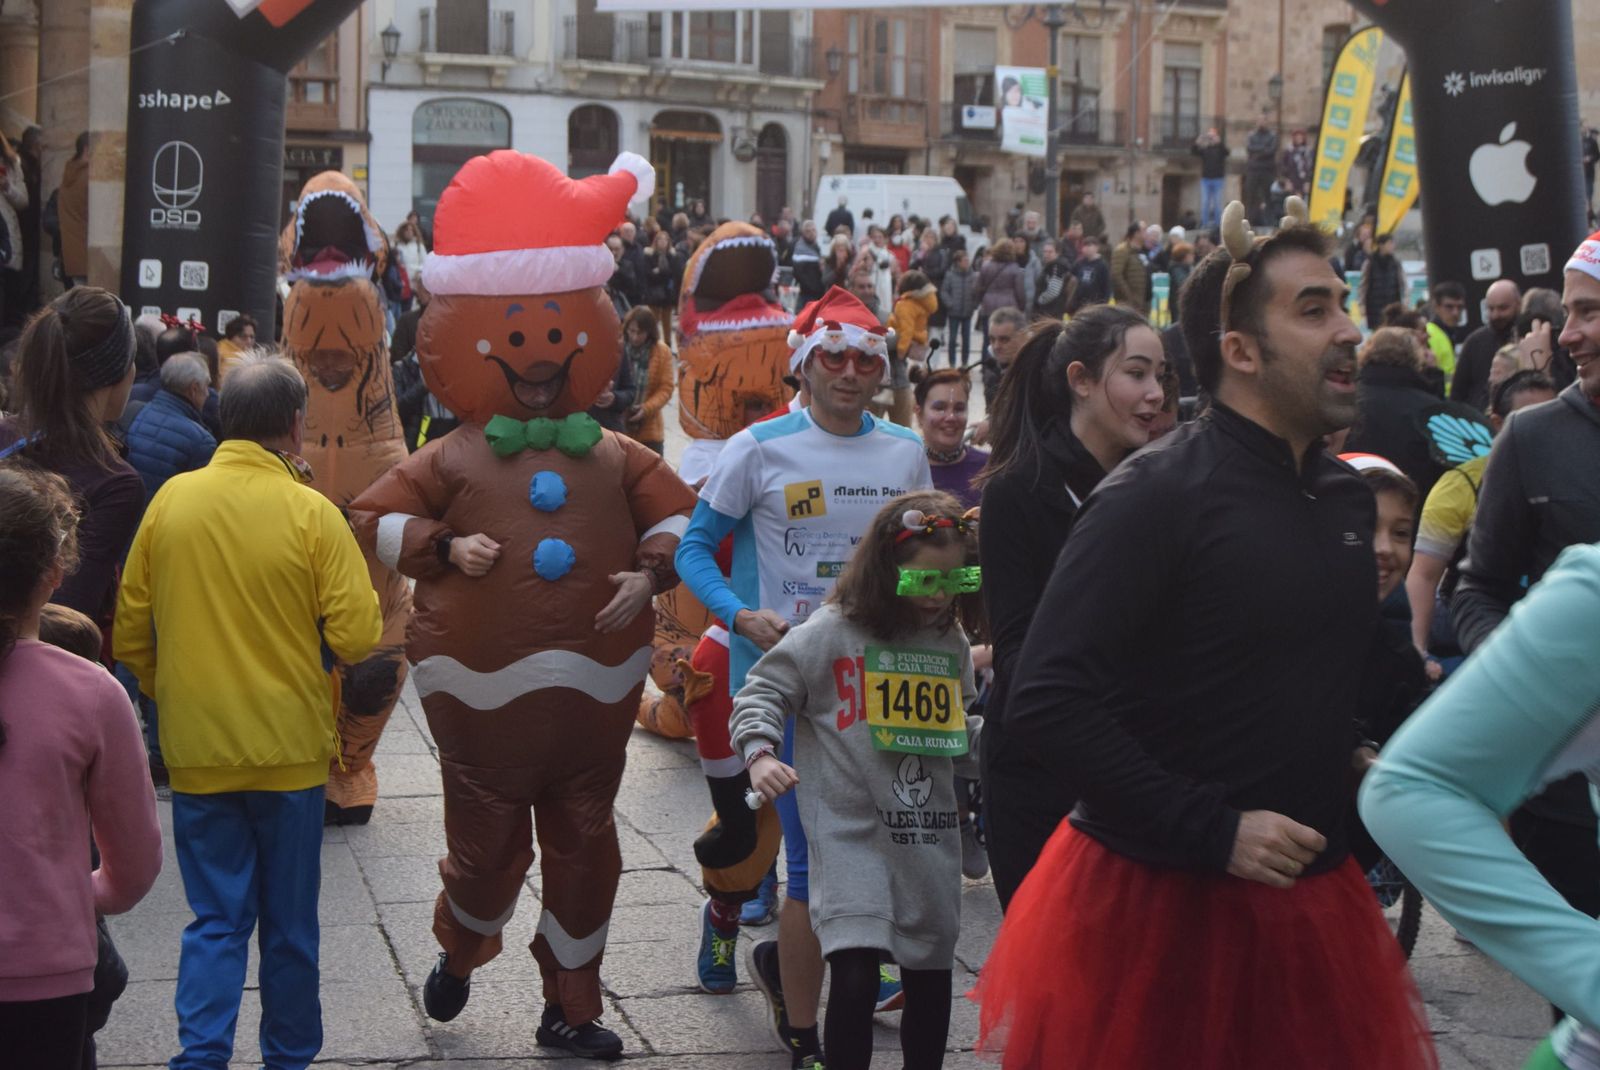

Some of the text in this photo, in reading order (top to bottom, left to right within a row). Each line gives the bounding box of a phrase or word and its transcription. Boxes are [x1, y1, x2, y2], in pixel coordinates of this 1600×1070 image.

[1469, 66, 1542, 89] invisalign
[138, 89, 212, 112] 3shape
[150, 208, 202, 225] DSD
[897, 662, 950, 676] CAJA RURAL
[876, 678, 951, 724] 1469
[896, 734, 962, 749] CAJA RURAL
